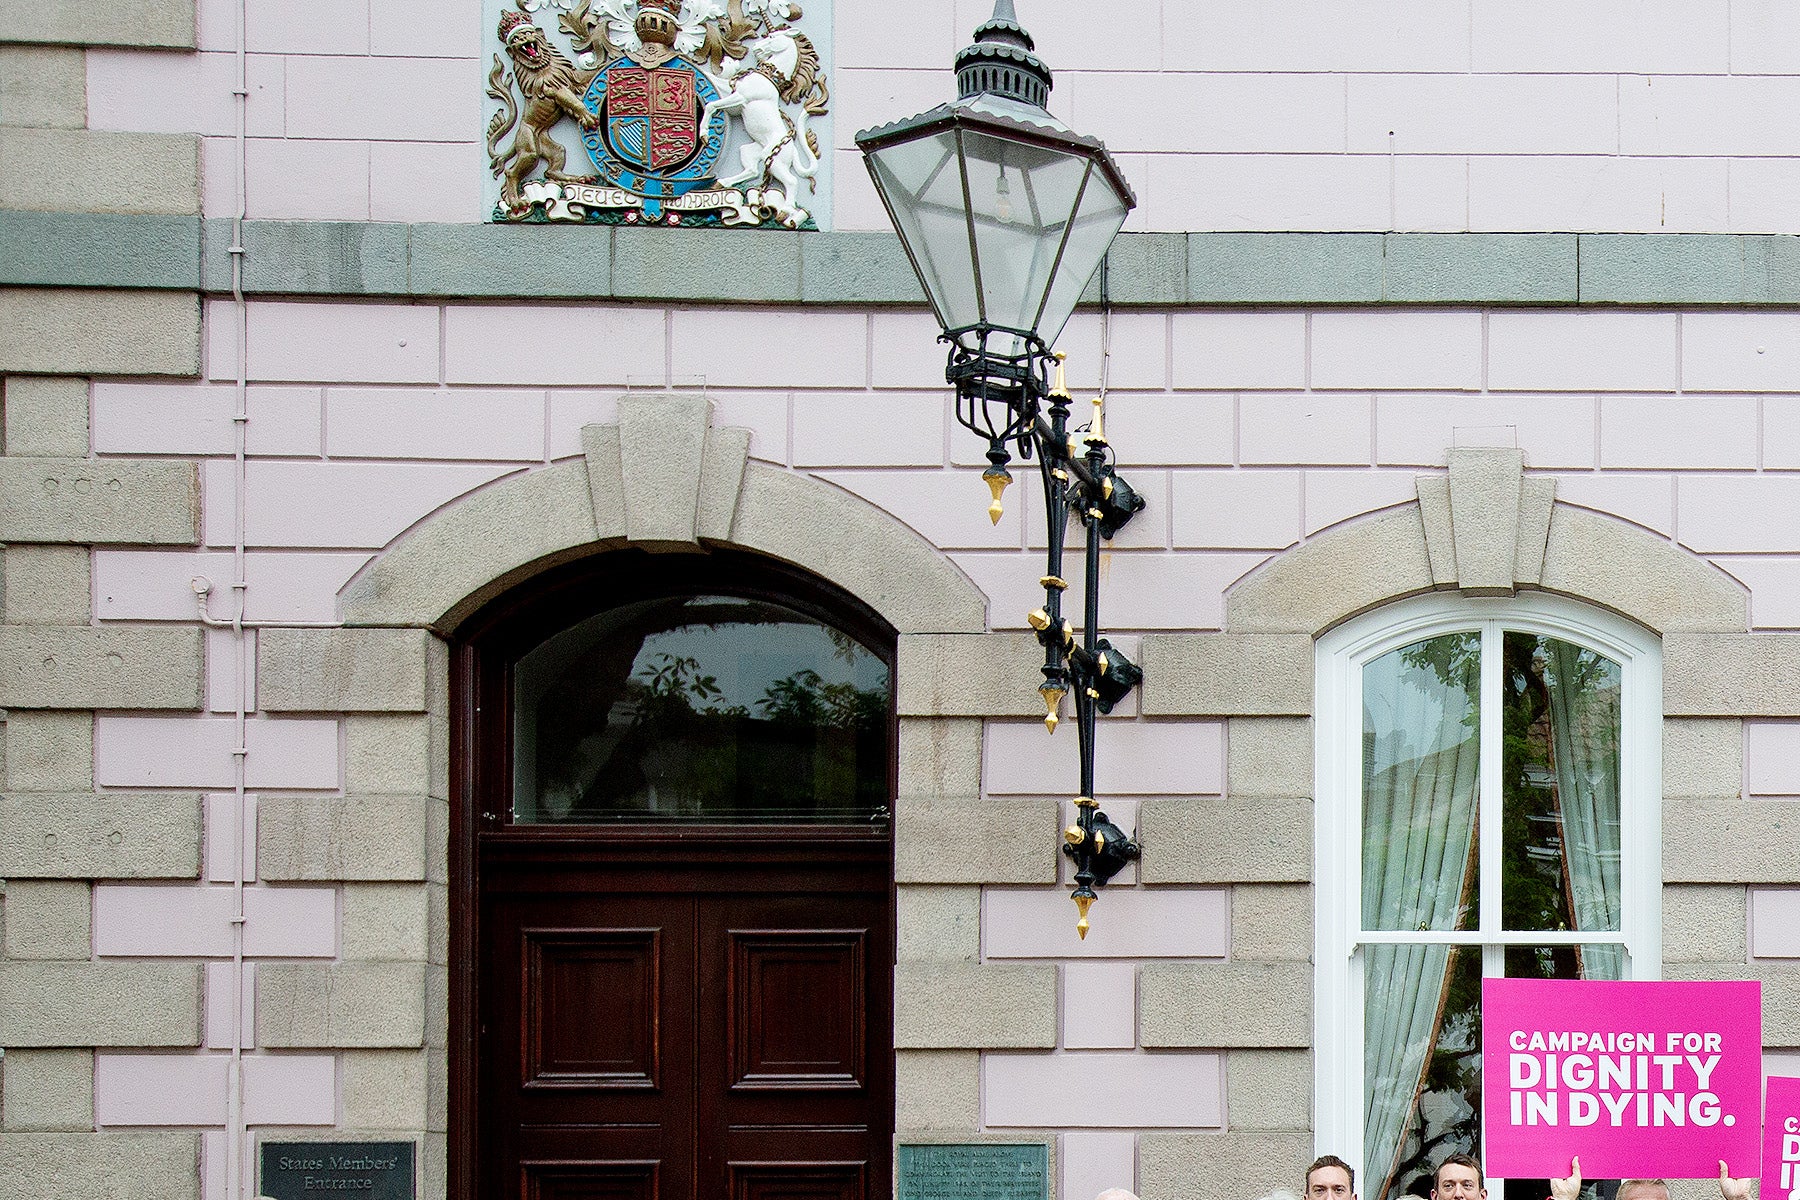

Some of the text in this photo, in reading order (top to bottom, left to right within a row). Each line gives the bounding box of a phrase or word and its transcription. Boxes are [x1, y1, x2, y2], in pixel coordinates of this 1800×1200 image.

[1509, 1030, 1722, 1053] CAMPAIGN FOR
[1509, 1053, 1722, 1090] DIGNITY
[1510, 1091, 1736, 1127] IN DYING.
[279, 1156, 398, 1170] States Members'
[304, 1176, 373, 1190] Entrance
